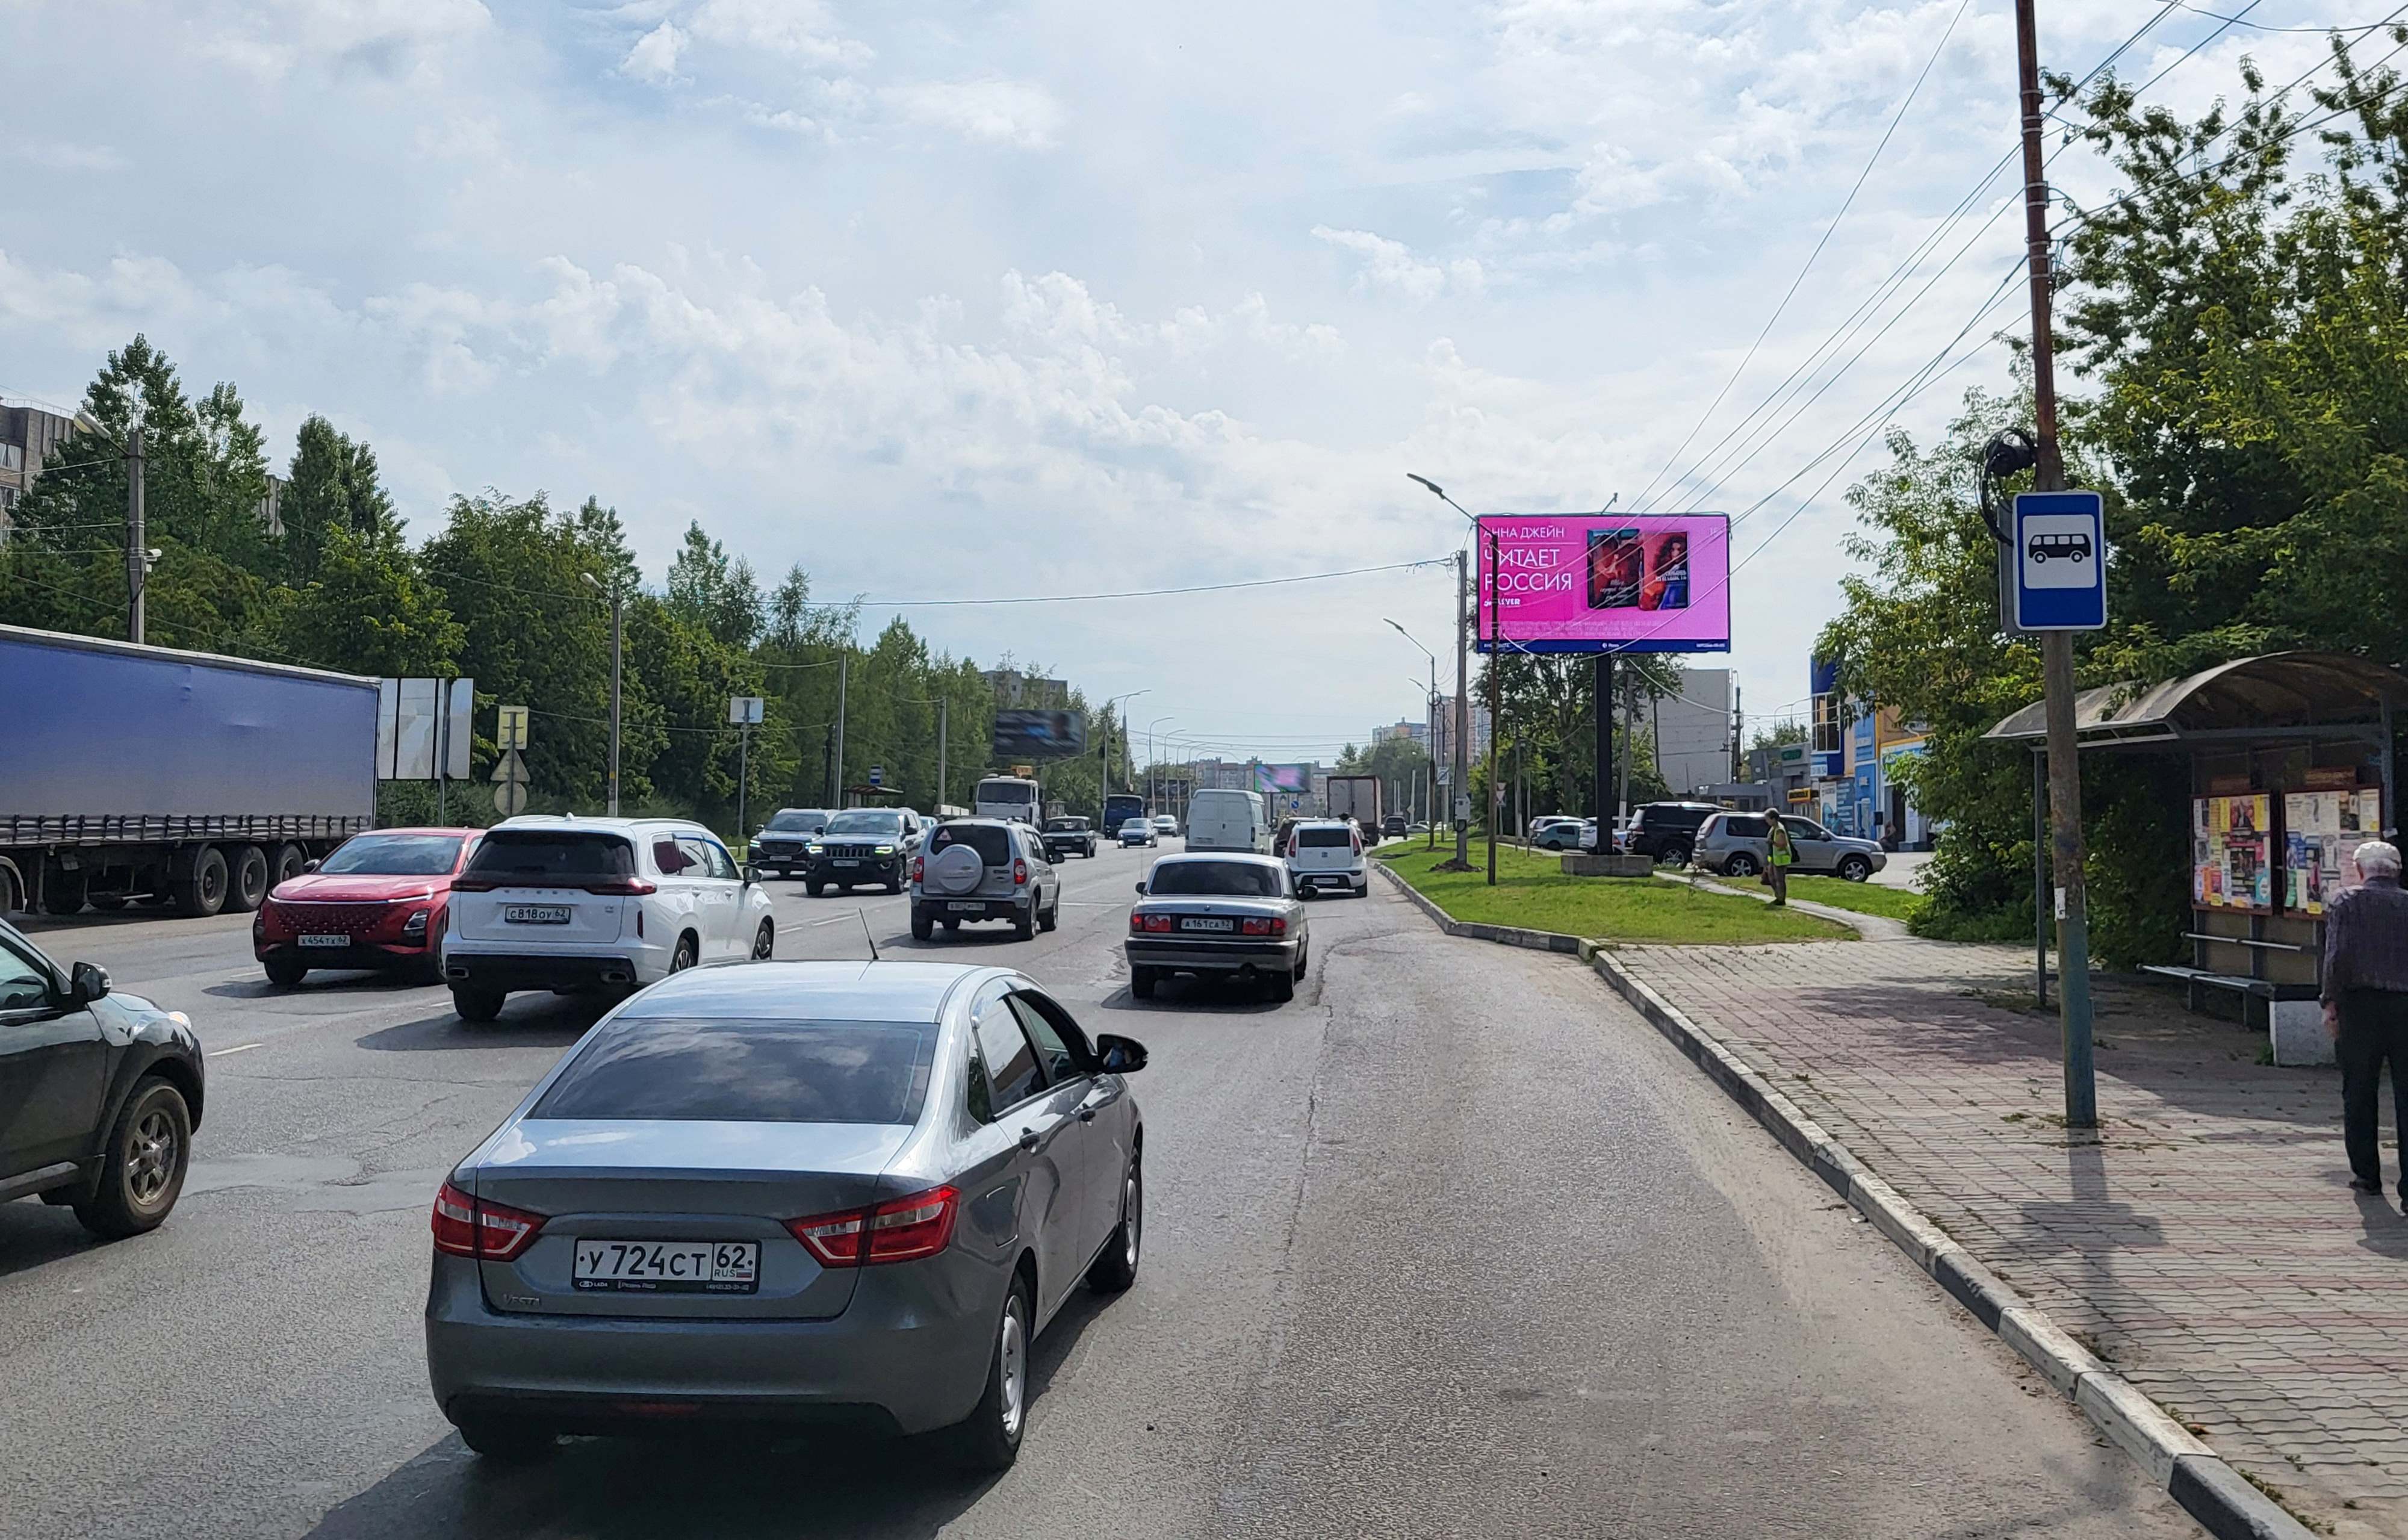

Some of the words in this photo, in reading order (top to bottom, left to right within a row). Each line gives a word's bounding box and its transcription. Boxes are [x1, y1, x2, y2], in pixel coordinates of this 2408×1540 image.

[1483, 527, 1518, 538] АННА
[1520, 525, 1565, 539] ДЖЕЙН
[1484, 548, 1560, 567] ЧИТАЕТ
[1485, 573, 1572, 591] РОССИЯ
[555, 909, 566, 917] 62
[589, 1244, 707, 1277] У724СТ
[716, 1245, 746, 1269] 62
[714, 1268, 736, 1278] RUS
